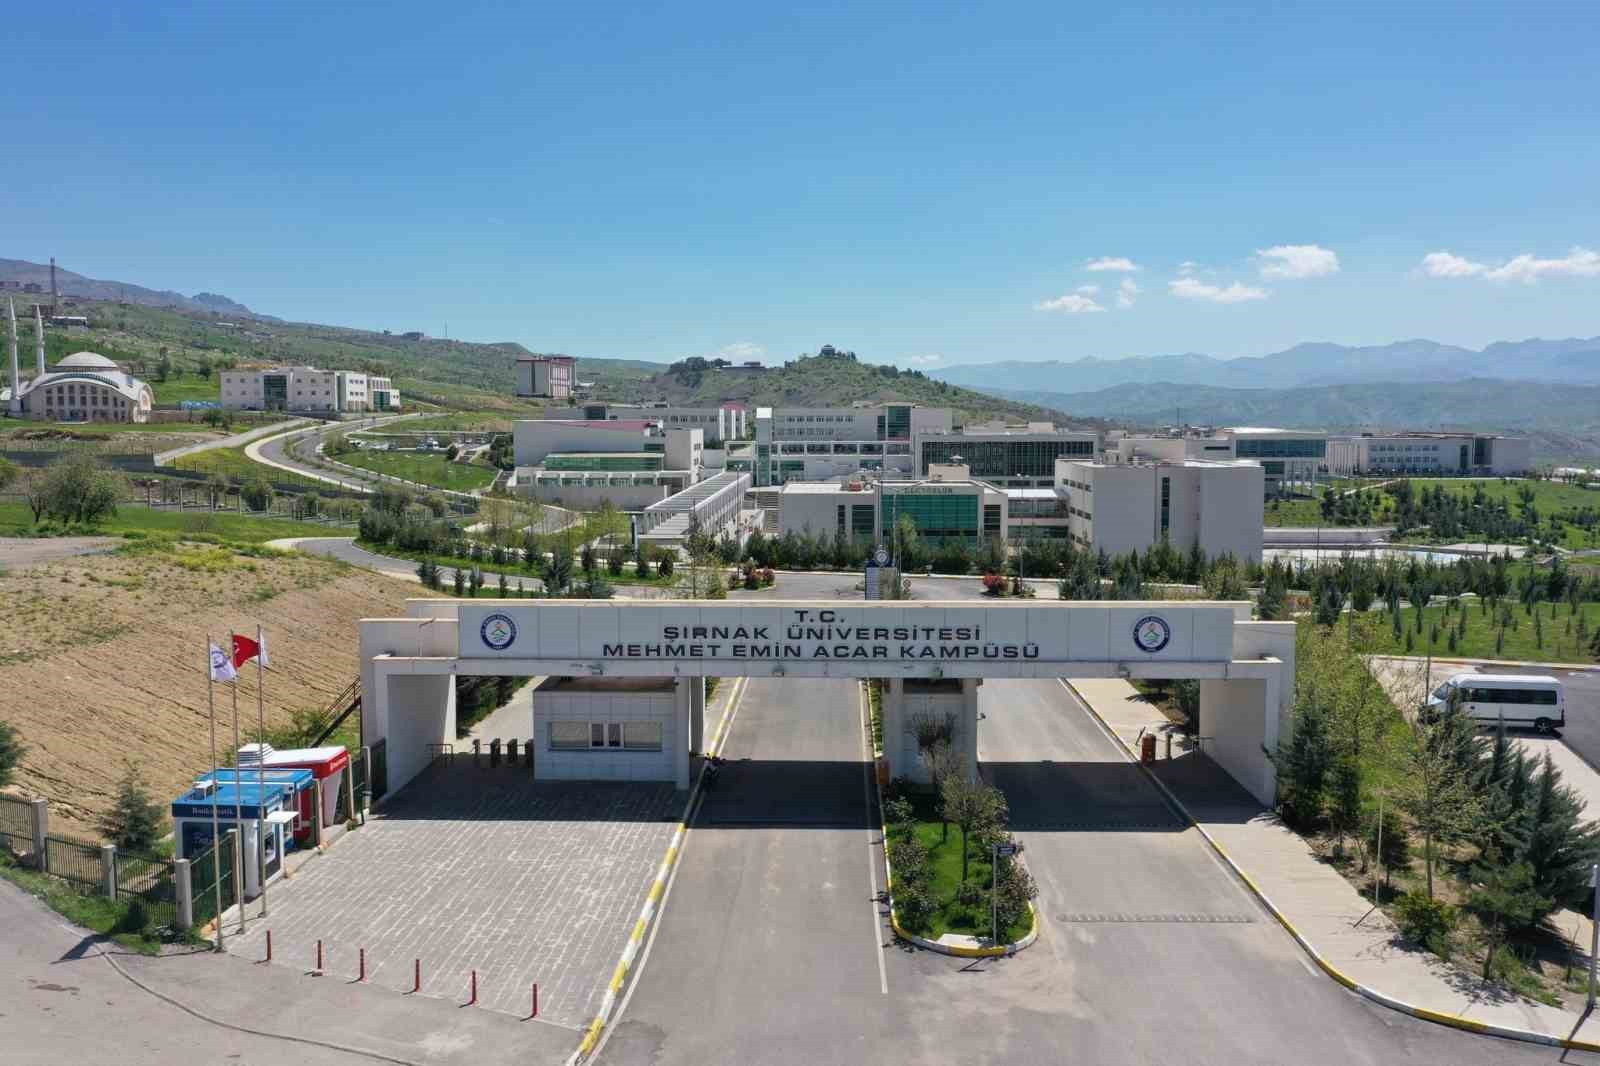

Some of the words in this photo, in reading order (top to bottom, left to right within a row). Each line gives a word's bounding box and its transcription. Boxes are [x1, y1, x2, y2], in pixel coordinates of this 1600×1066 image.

[794, 610, 845, 623] T.C.
[663, 626, 769, 642] ŞIRNAK
[787, 624, 980, 640] ÜNİVERSİTESİ
[603, 644, 721, 657] MEHMET
[732, 642, 800, 657] EMİN
[813, 645, 888, 658] ACAR
[900, 643, 1039, 658] KAMPÜSÜ
